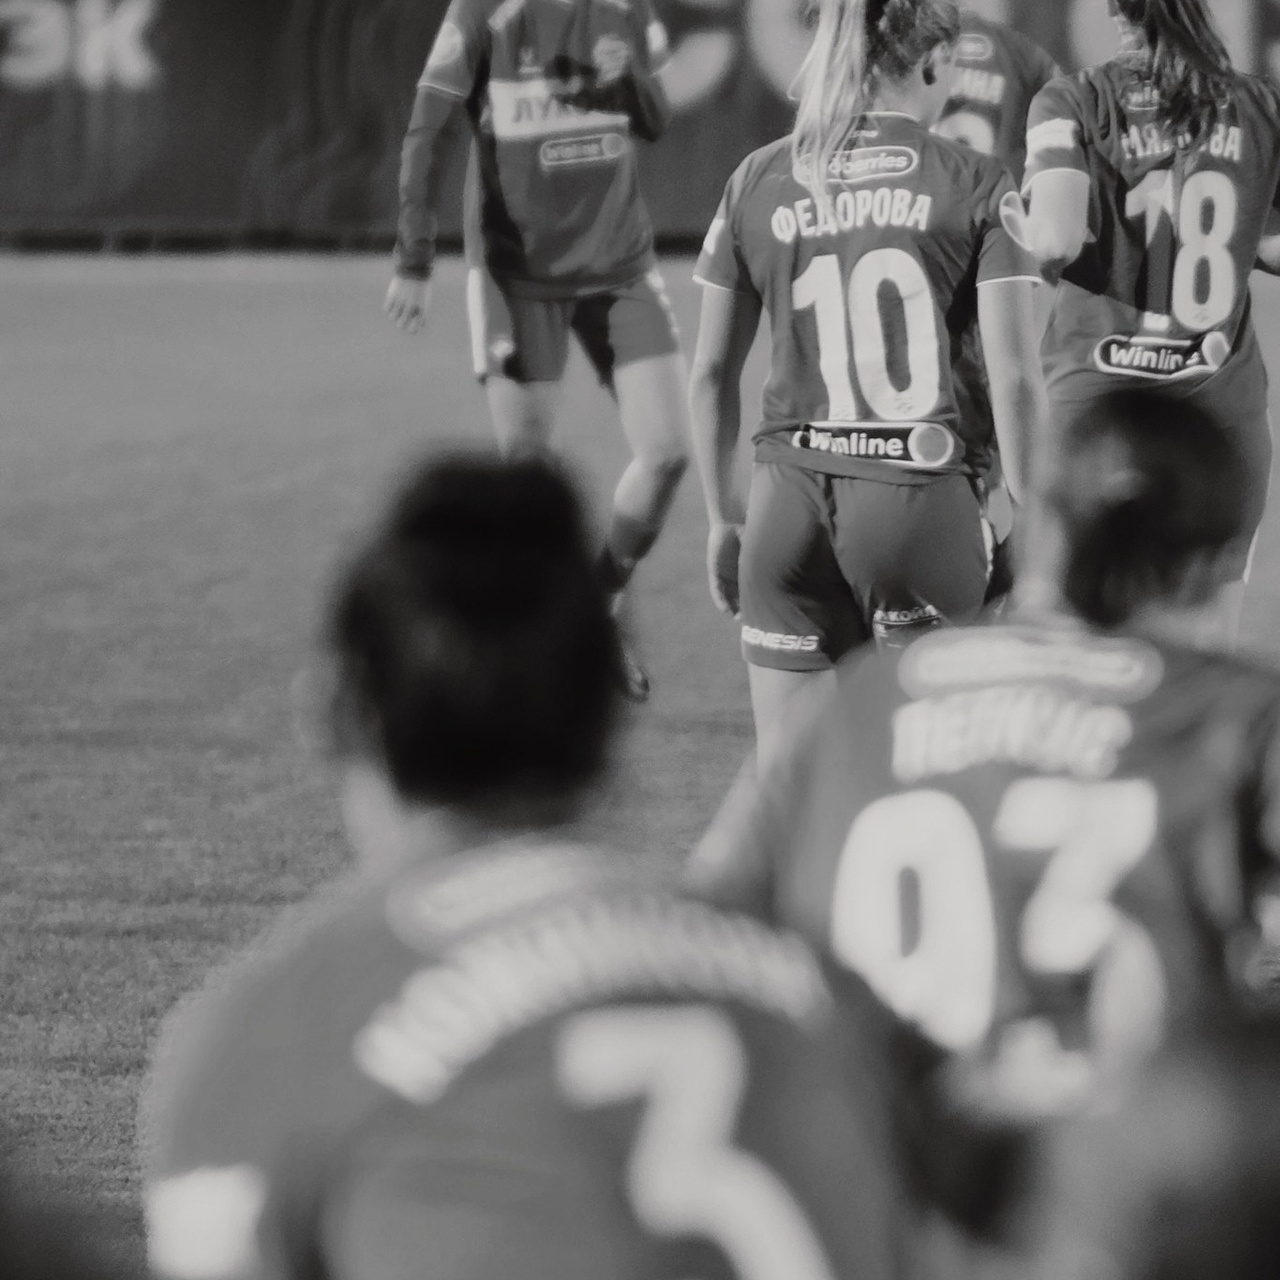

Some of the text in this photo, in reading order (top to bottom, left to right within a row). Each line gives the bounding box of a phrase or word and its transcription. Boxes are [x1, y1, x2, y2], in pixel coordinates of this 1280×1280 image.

[771, 187, 932, 244] ФЕДОРОВА
[1125, 169, 1236, 332] 18
[792, 247, 940, 421] 10
